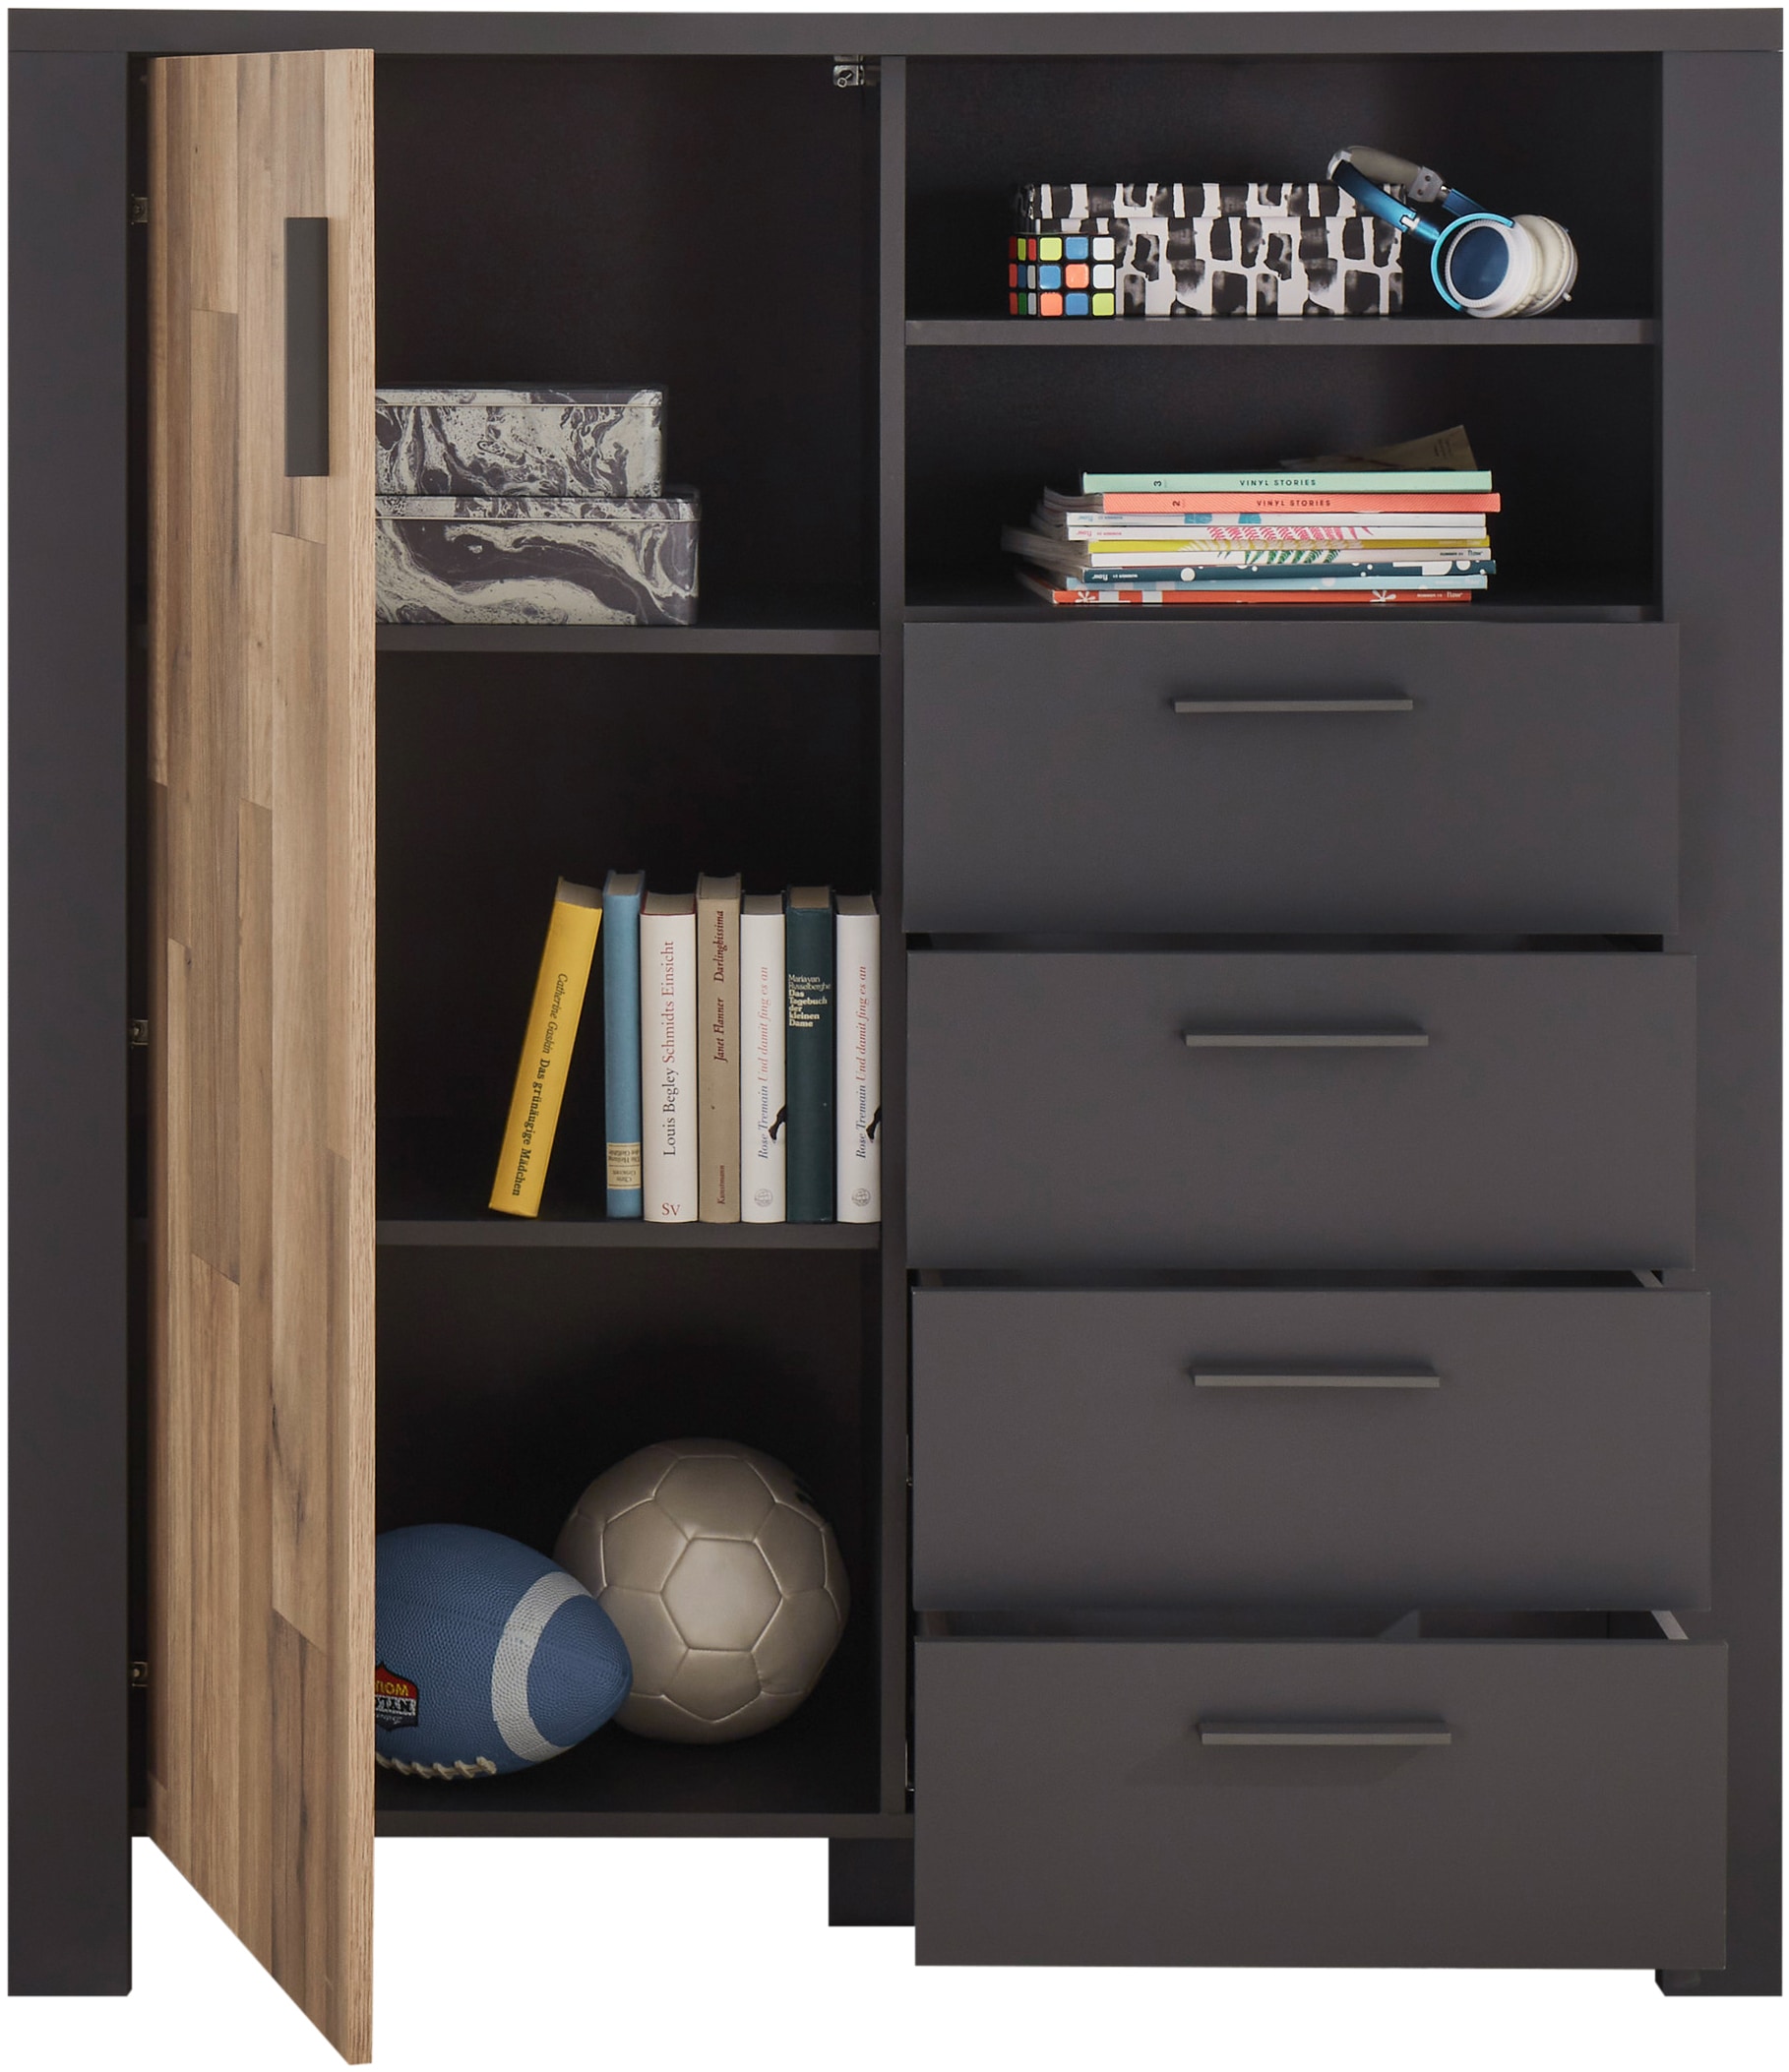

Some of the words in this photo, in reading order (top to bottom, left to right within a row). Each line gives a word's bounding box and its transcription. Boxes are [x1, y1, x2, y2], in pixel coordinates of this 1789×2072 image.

[660, 941, 675, 997] Einsicht
[762, 966, 769, 981] an
[860, 966, 866, 980] an
[550, 973, 569, 1019] Catherine
[762, 985, 769, 996] es
[788, 989, 805, 998] Das
[788, 996, 828, 1006] Tagebuch
[860, 984, 866, 996] es
[712, 998, 725, 1035] Flanner
[757, 998, 771, 1022] fing
[788, 1004, 803, 1012] der
[854, 998, 868, 1021] fing
[660, 1001, 675, 1064] Schmidts
[788, 1018, 814, 1027] Dame
[542, 1020, 558, 1055] Gaskin
[713, 1037, 729, 1064] Janet
[757, 1023, 769, 1057] damit
[854, 1023, 866, 1057] damit
[536, 1058, 551, 1080] Das
[758, 1057, 769, 1082] Und
[856, 1057, 866, 1082] Und
[661, 1067, 679, 1113] Begley
[521, 1081, 543, 1145] grünäugige
[758, 1085, 769, 1130] Tremain
[856, 1084, 866, 1129] Tremain
[662, 1117, 677, 1156] Louis
[758, 1133, 769, 1160] Rose
[856, 1133, 866, 1159] Rose
[512, 1147, 531, 1197] Mädchen
[661, 1202, 681, 1217] SV
[375, 1697, 412, 1713] NYL
